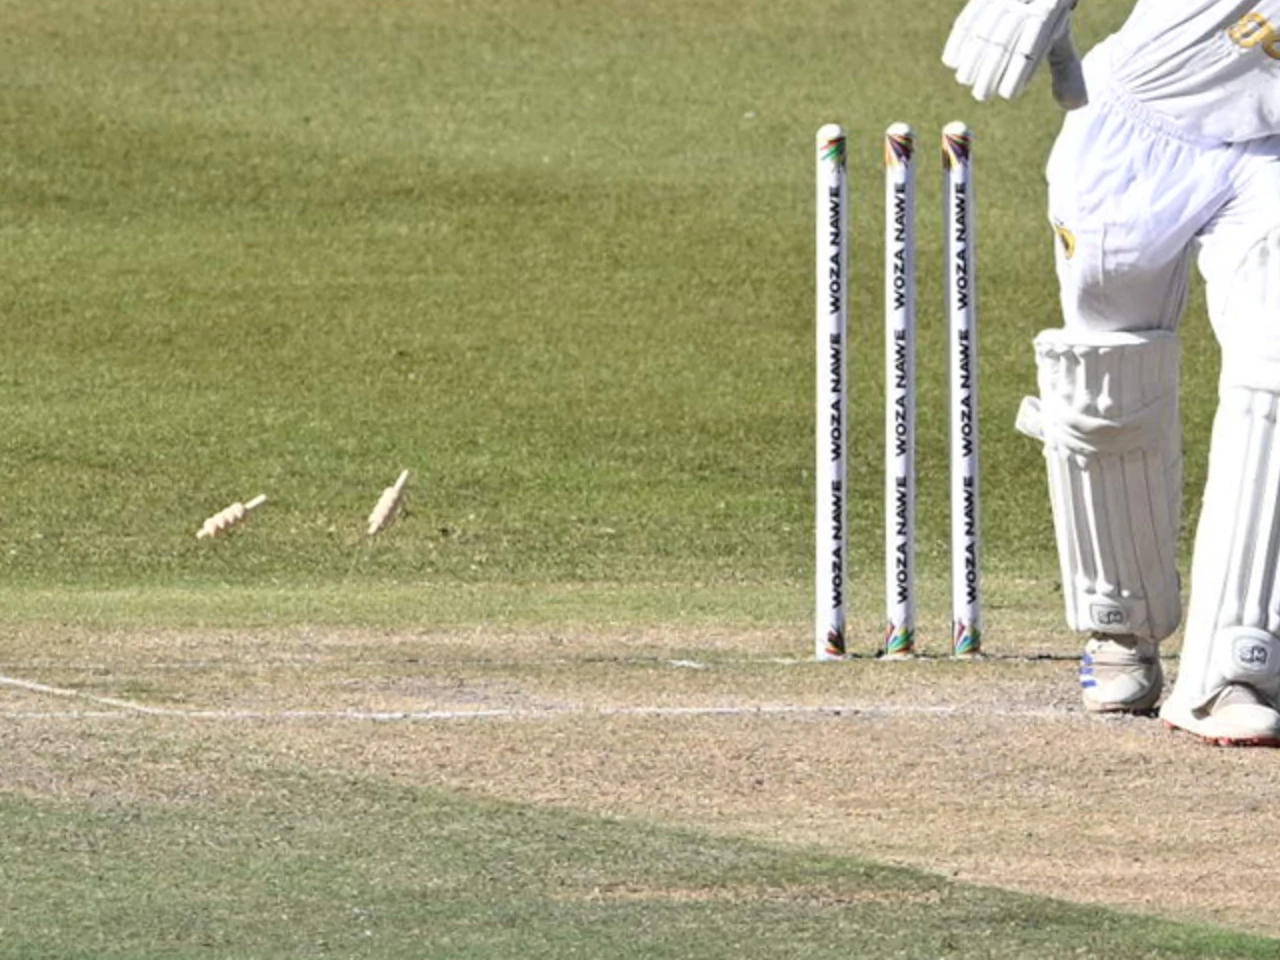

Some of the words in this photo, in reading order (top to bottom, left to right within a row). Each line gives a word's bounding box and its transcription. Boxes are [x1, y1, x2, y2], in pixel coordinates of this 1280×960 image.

[829, 185, 842, 247] NAWE
[895, 183, 907, 242] NAWE
[955, 182, 968, 243] NAWE
[829, 251, 842, 314] WOZA
[894, 248, 906, 309] WOZA
[956, 248, 969, 309] WOZA
[831, 332, 842, 394] NAWE
[895, 329, 908, 389] NAWE
[959, 329, 972, 390] NAWE
[831, 398, 843, 461] WOZA
[895, 395, 908, 456] WOZA
[961, 394, 974, 457] WOZA
[831, 479, 843, 541] NAWE
[896, 476, 908, 536] NAWE
[963, 475, 976, 537] NAWE
[832, 545, 843, 609] WOZA
[896, 541, 909, 603] WOZA
[965, 541, 978, 604] WOZA
